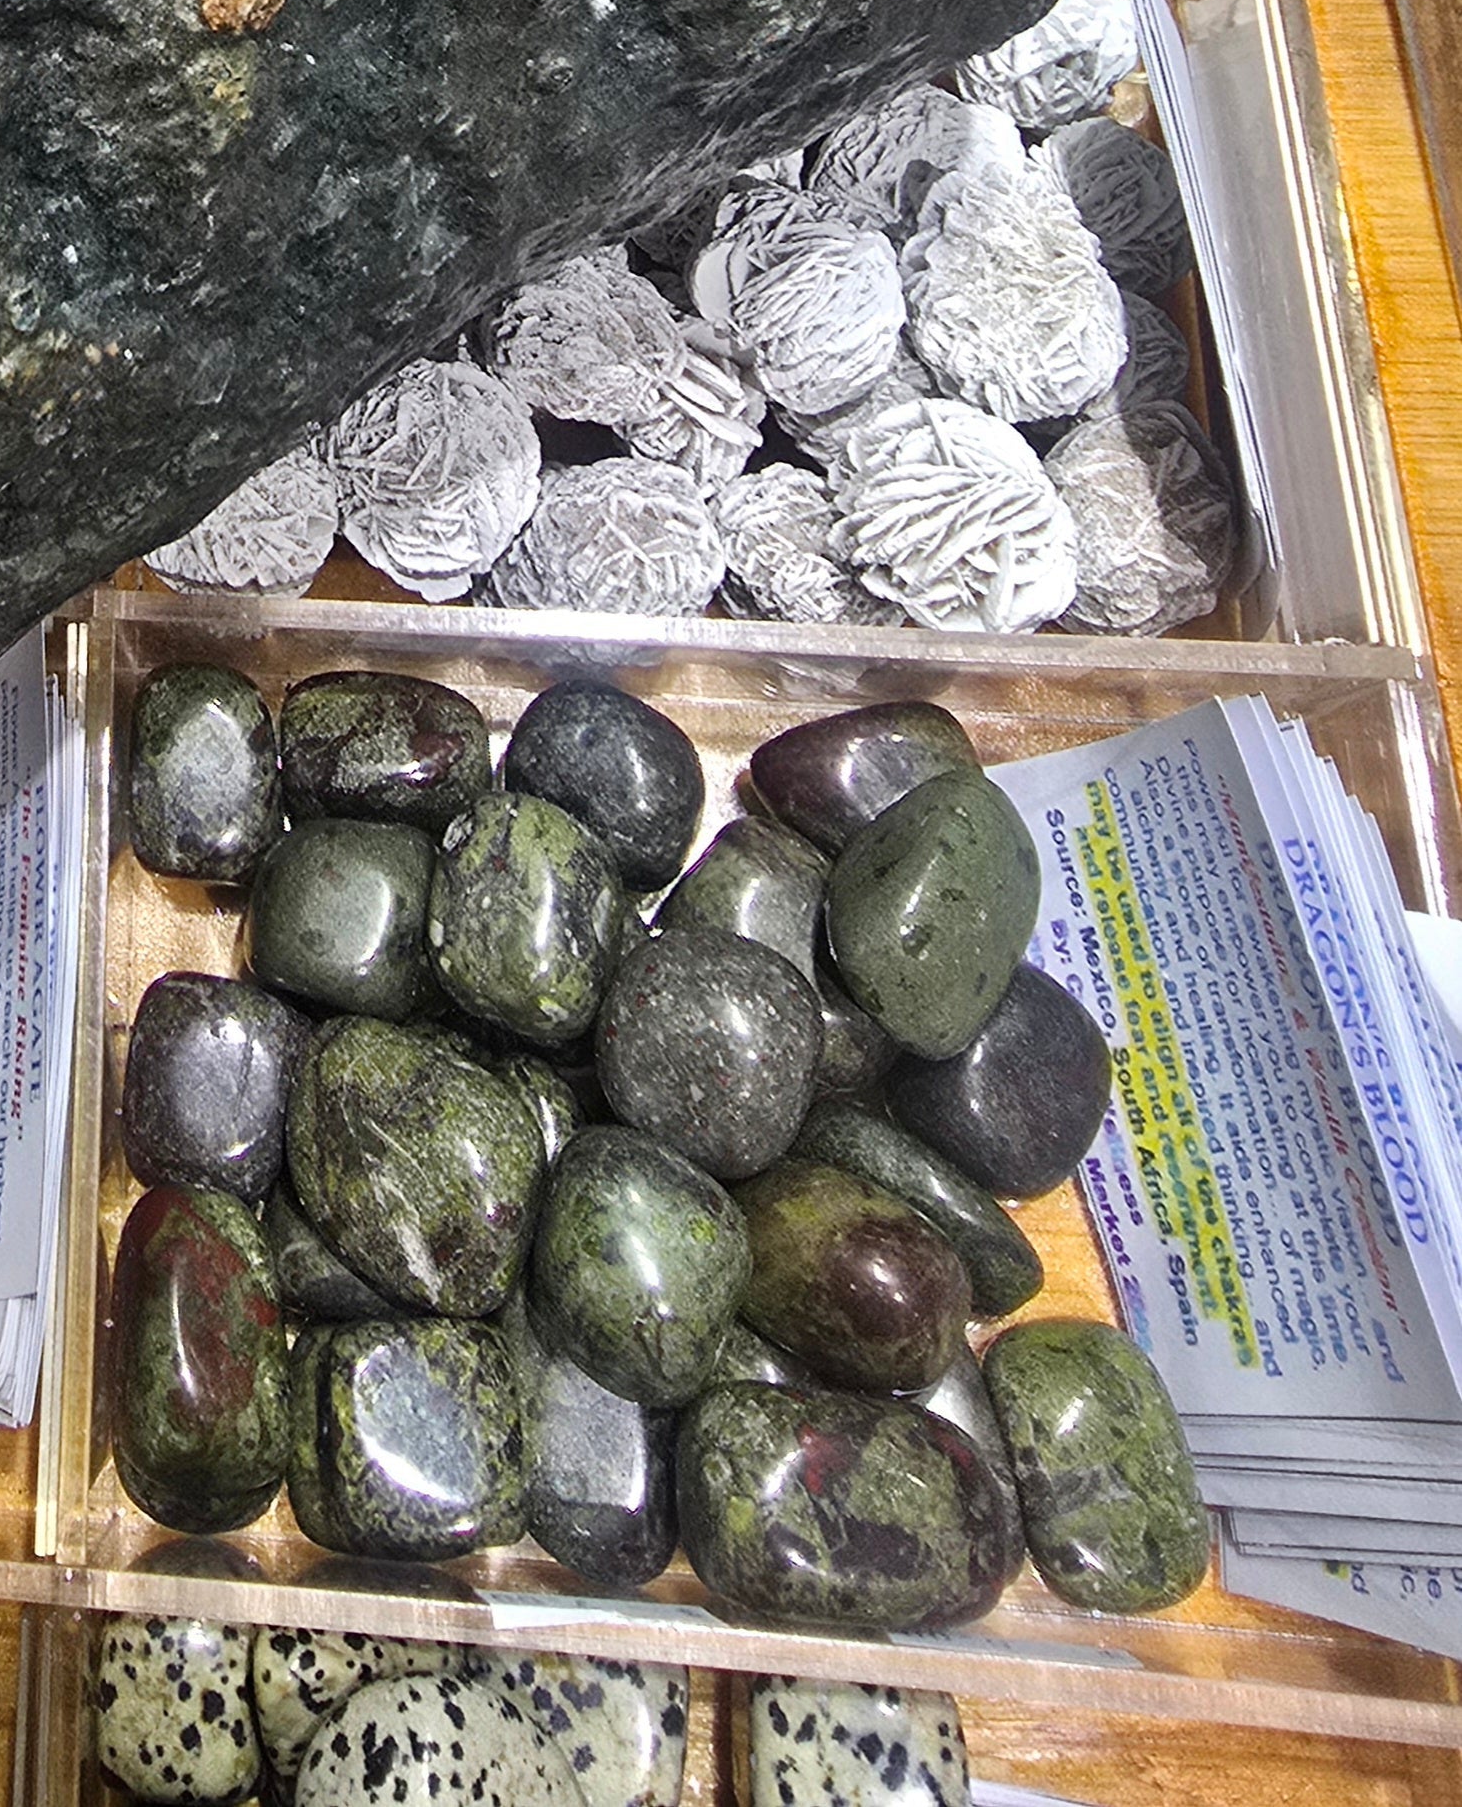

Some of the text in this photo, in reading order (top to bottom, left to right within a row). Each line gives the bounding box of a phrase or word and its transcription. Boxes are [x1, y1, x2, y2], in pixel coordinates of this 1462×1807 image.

[8, 779, 20, 858] Agate
[1126, 787, 1175, 904] alchemy
[1154, 754, 1192, 839] Divine
[6, 865, 18, 939] helps
[17, 852, 30, 1002] Feminine
[29, 782, 45, 1104] FLOWER AGATE
[1047, 917, 1076, 966] By:
[1163, 908, 1192, 963] and
[1180, 845, 1230, 963] purpose
[4, 948, 13, 981] us
[1074, 823, 1103, 879] and
[1092, 885, 1133, 991] release
[1123, 999, 1151, 1056] fear
[1139, 1065, 1169, 1122] and
[1221, 969, 1246, 1008] for
[1, 988, 13, 1070] reach
[1044, 806, 1089, 919] Source:
[1075, 924, 1122, 1038] Mexico,
[1109, 1044, 1152, 1136] South
[1134, 1144, 1178, 1246] Africa,
[1161, 1252, 1205, 1347] Spain
[1084, 778, 1258, 1366] may be used to align all of the chakras
[1102, 765, 1173, 970] communication
[1161, 975, 1190, 1030] and
[1178, 1038, 1226, 1154] inspired
[1250, 1317, 1284, 1377] and
[1161, 833, 1177, 852] a
[1169, 858, 1204, 938] stone
[1193, 943, 1216, 974] of
[1276, 1226, 1303, 1261] of
[1174, 763, 1374, 1356] this may empower you to complete your
[1181, 735, 1235, 859] Powerful
[1225, 865, 1250, 902] for
[1238, 910, 1305, 1071] awakening
[1289, 1078, 1340, 1179] mystic
[1367, 1317, 1407, 1384] and
[1254, 840, 1406, 1249] DRAGON'S BLOOD
[1282, 838, 1430, 1245] DRAGON'S BLOOD
[1217, 1092, 1235, 1111] It
[1223, 1118, 1256, 1182] aids
[1233, 1015, 1300, 1181] incarnating
[1302, 1046, 1352, 1155] Wealth
[1084, 1155, 1133, 1267] Market
[1287, 1189, 1311, 1219] at
[1298, 1228, 1330, 1284] this
[1240, 1189, 1301, 1344] enhanced
